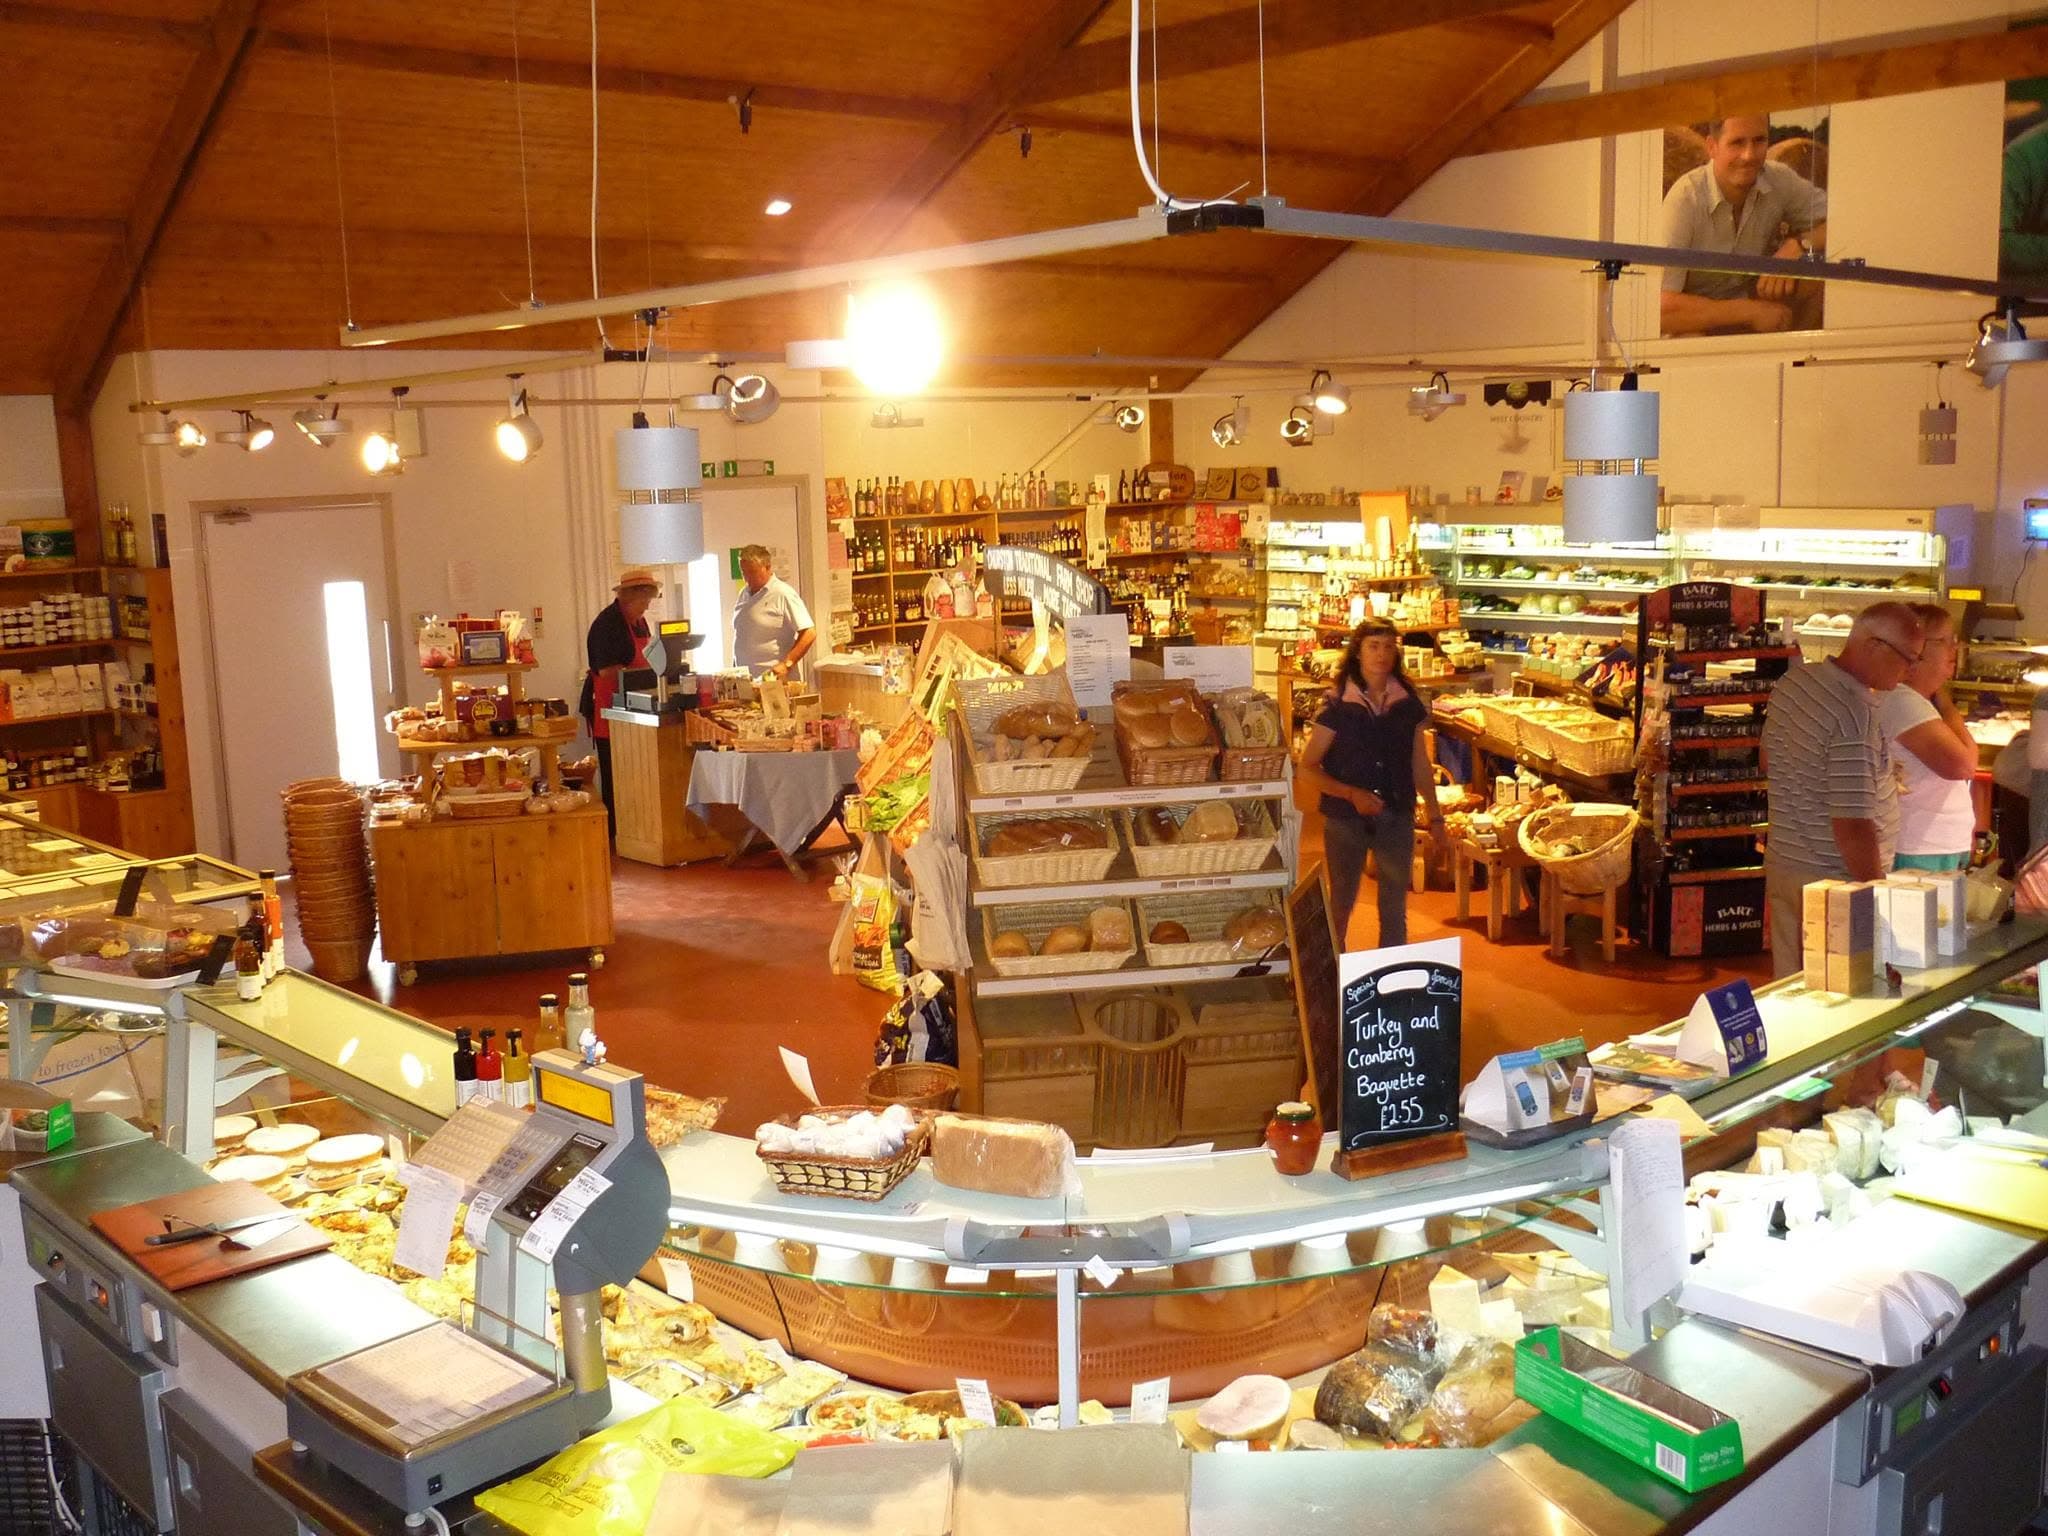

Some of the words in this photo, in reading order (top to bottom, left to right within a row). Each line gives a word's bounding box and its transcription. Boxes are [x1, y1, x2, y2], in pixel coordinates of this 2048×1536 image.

[1002, 575, 1017, 596] LESS
[1043, 582, 1060, 613] MORE
[1056, 562, 1073, 598] FARM
[1075, 574, 1095, 610] SHOP
[1682, 584, 1719, 597] BART
[1672, 600, 1695, 610] HERBS
[1696, 600, 1703, 610] &
[1703, 599, 1729, 610] SPICES
[1716, 905, 1754, 920] BART
[1704, 922, 1730, 934] HERBS
[1731, 922, 1738, 931] &
[1738, 919, 1762, 931] SPICES
[1346, 977, 1377, 1002] Special
[1430, 968, 1461, 991] Special
[1350, 1007, 1403, 1049] Turkey
[1410, 1005, 1441, 1031] and
[38, 1064, 52, 1077] to
[56, 1053, 96, 1076] frozen
[1347, 1045, 1415, 1070] Cranberry
[1356, 1072, 1426, 1105] Baguette
[1380, 1095, 1424, 1132] £2.55
[1698, 1451, 1720, 1466] cling
[1719, 1445, 1736, 1458] film
